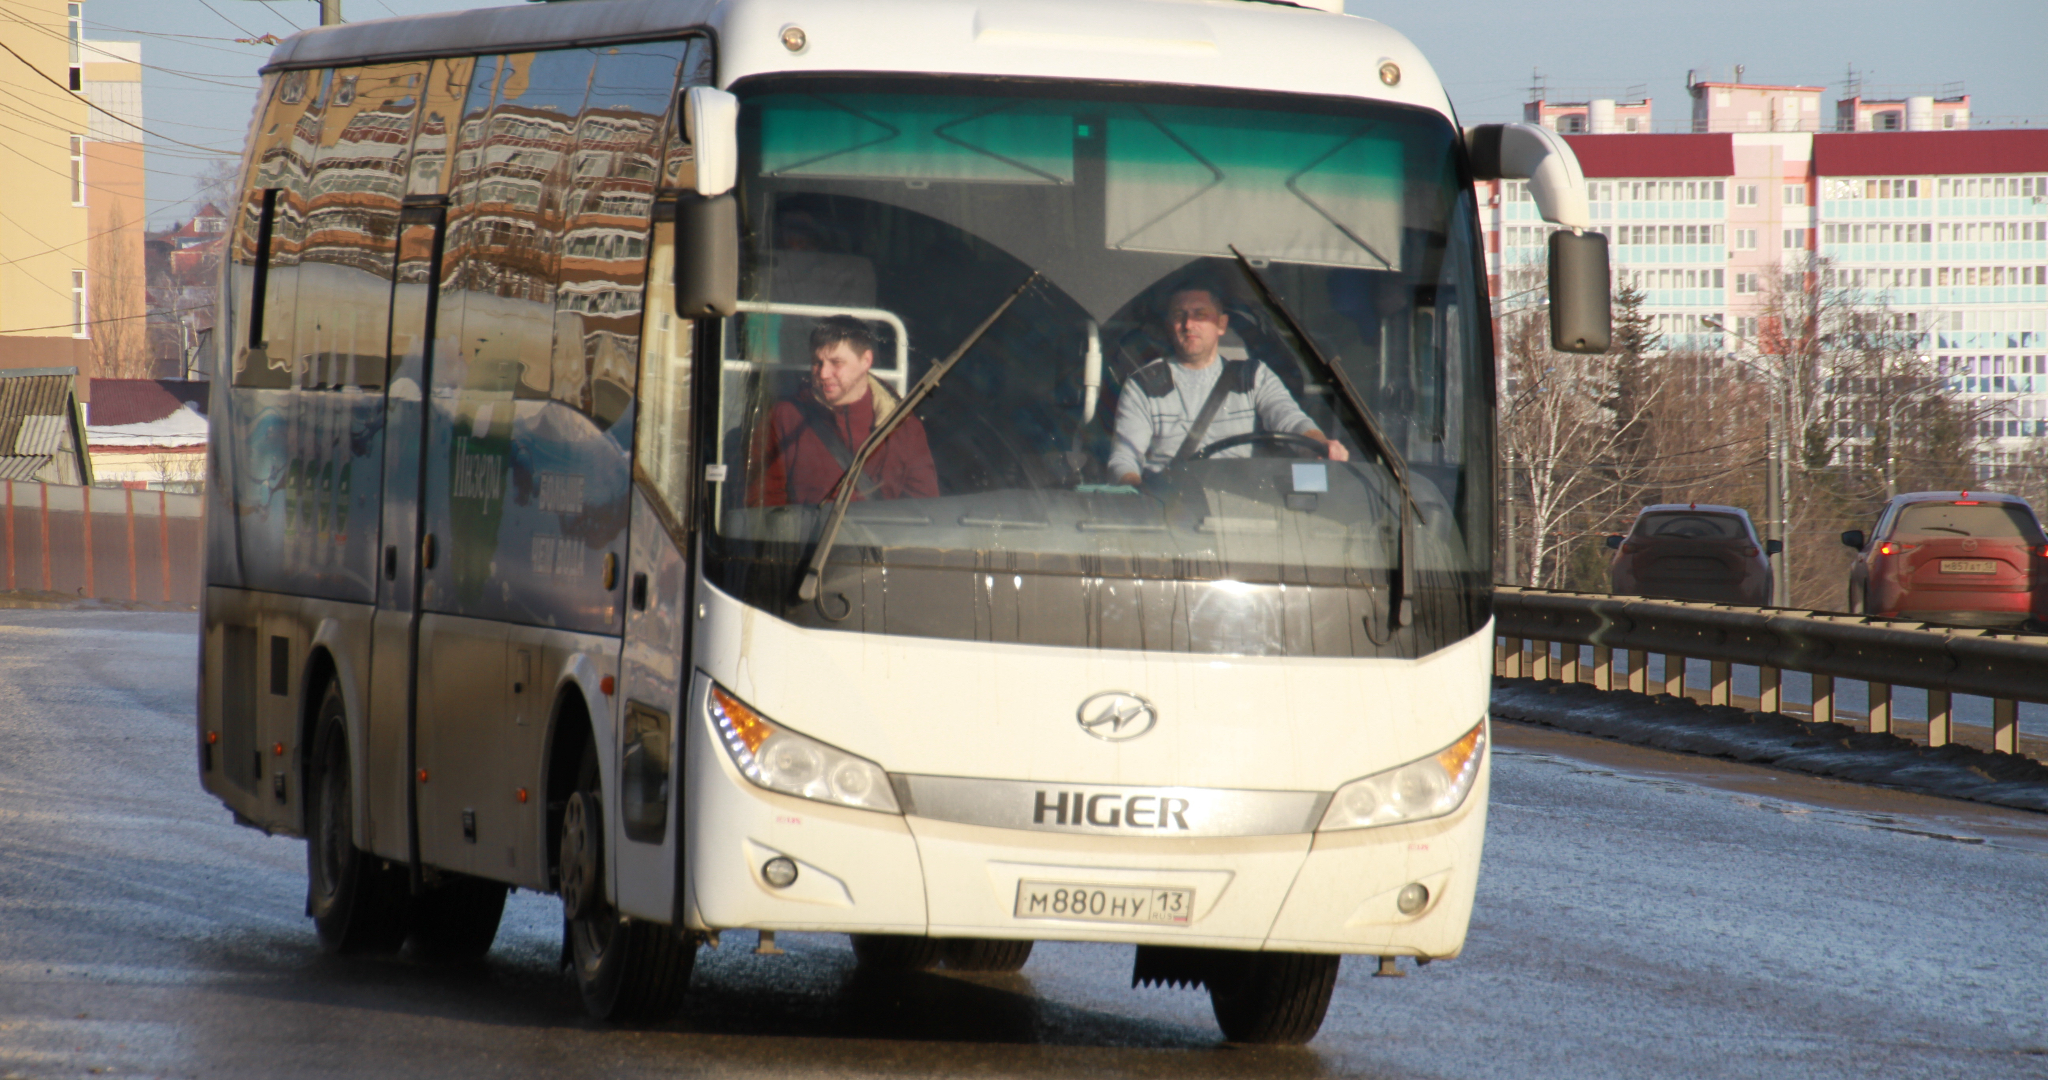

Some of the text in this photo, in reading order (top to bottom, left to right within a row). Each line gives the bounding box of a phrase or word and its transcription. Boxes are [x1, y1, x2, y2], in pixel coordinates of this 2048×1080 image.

[1033, 790, 1190, 830] HIGER
[1157, 891, 1183, 912] 13
[1152, 912, 1173, 921] RUS
